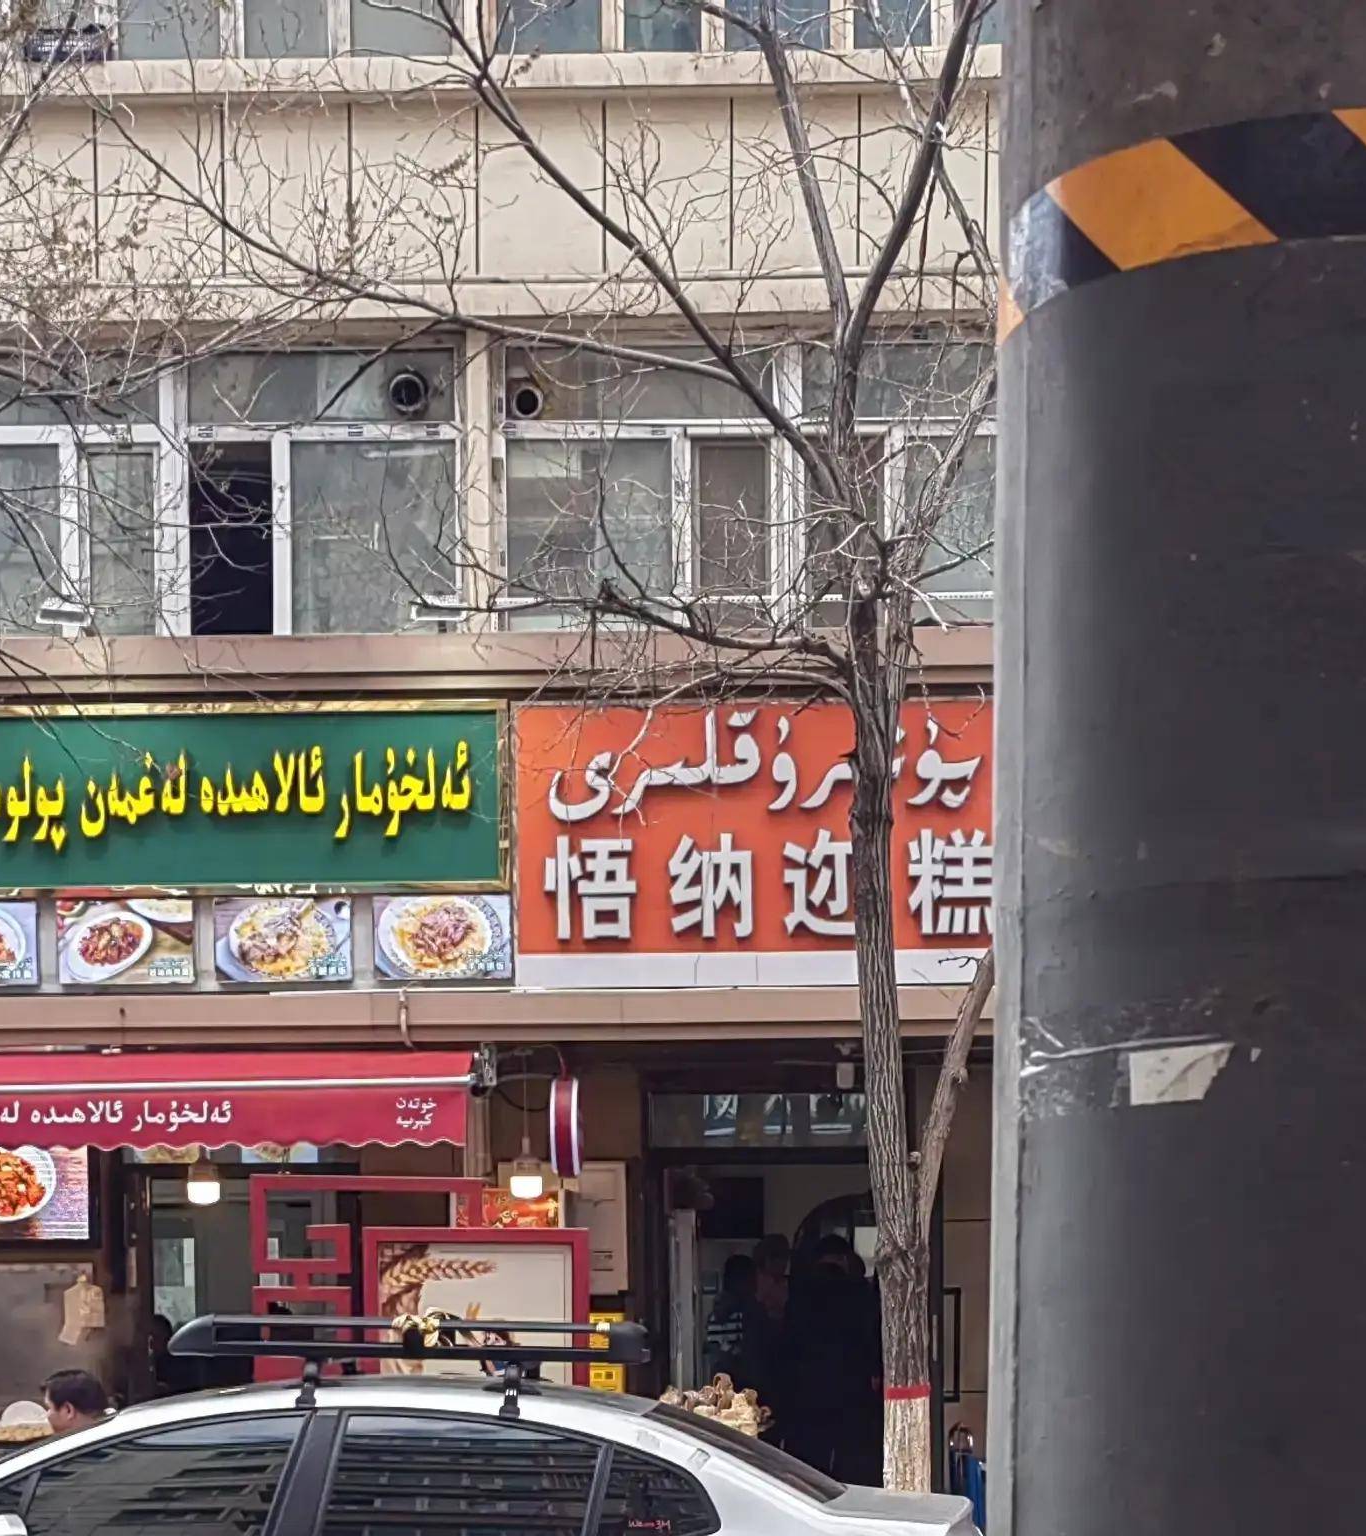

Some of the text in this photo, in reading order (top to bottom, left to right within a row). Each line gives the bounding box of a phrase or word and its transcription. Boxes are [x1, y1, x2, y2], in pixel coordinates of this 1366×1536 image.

[80, 750, 187, 839] لەغمەن
[334, 739, 471, 840] ئەلخۇمار
[132, 1100, 232, 1132] ئەلخۇمار
